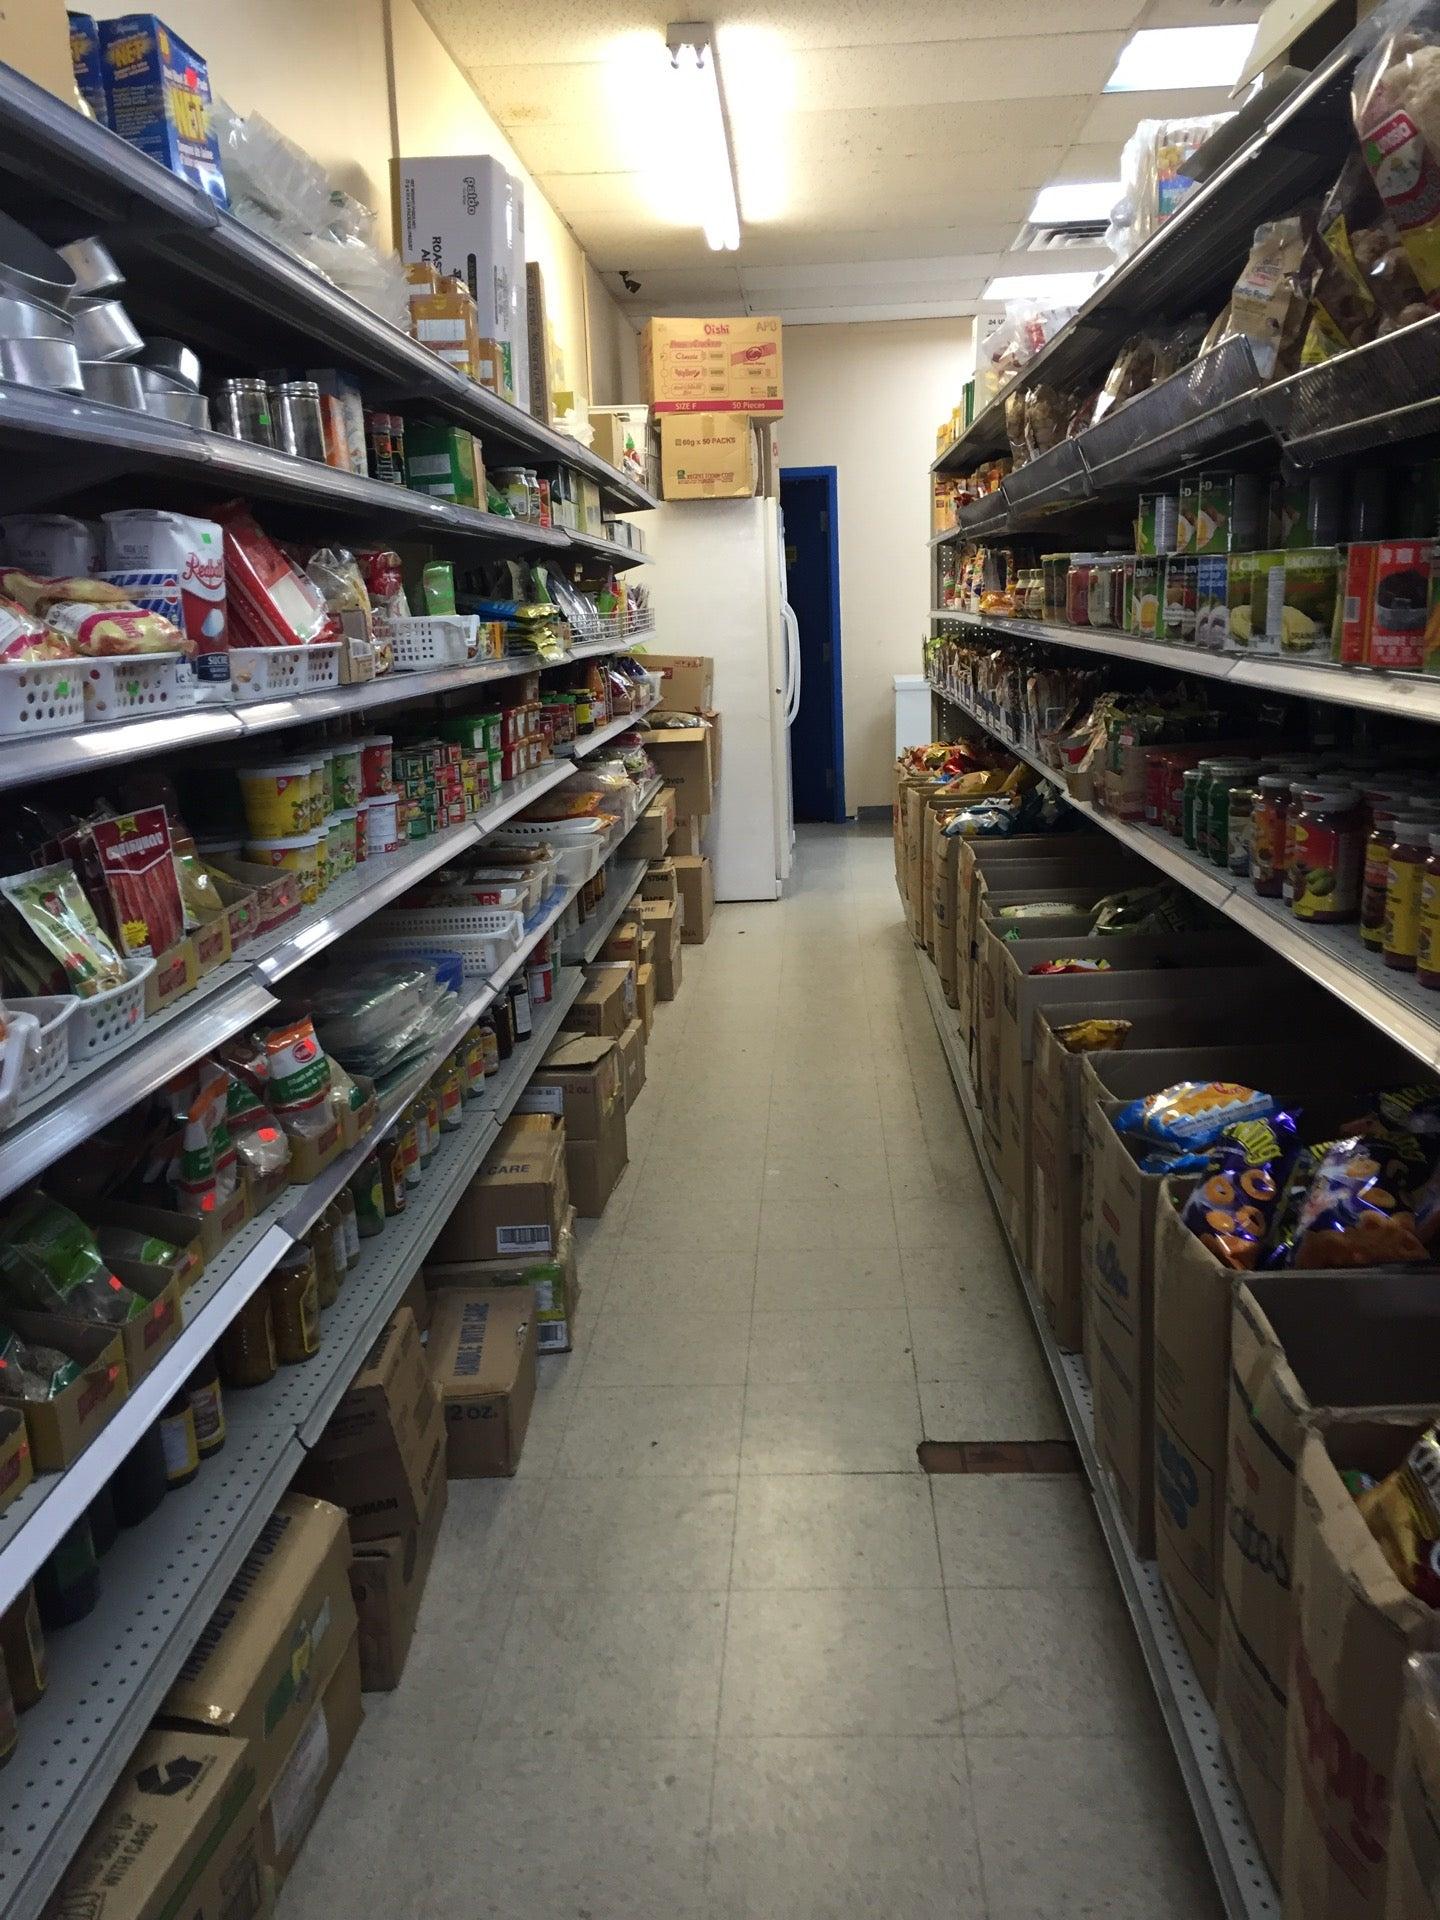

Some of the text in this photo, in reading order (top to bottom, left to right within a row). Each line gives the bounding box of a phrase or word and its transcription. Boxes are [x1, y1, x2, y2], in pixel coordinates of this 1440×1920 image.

[463, 176, 479, 216] paldo
[704, 324, 729, 335] Oishi
[675, 403, 691, 411] SIZE
[712, 437, 736, 445] PACKS
[488, 1164, 531, 1176] CARE
